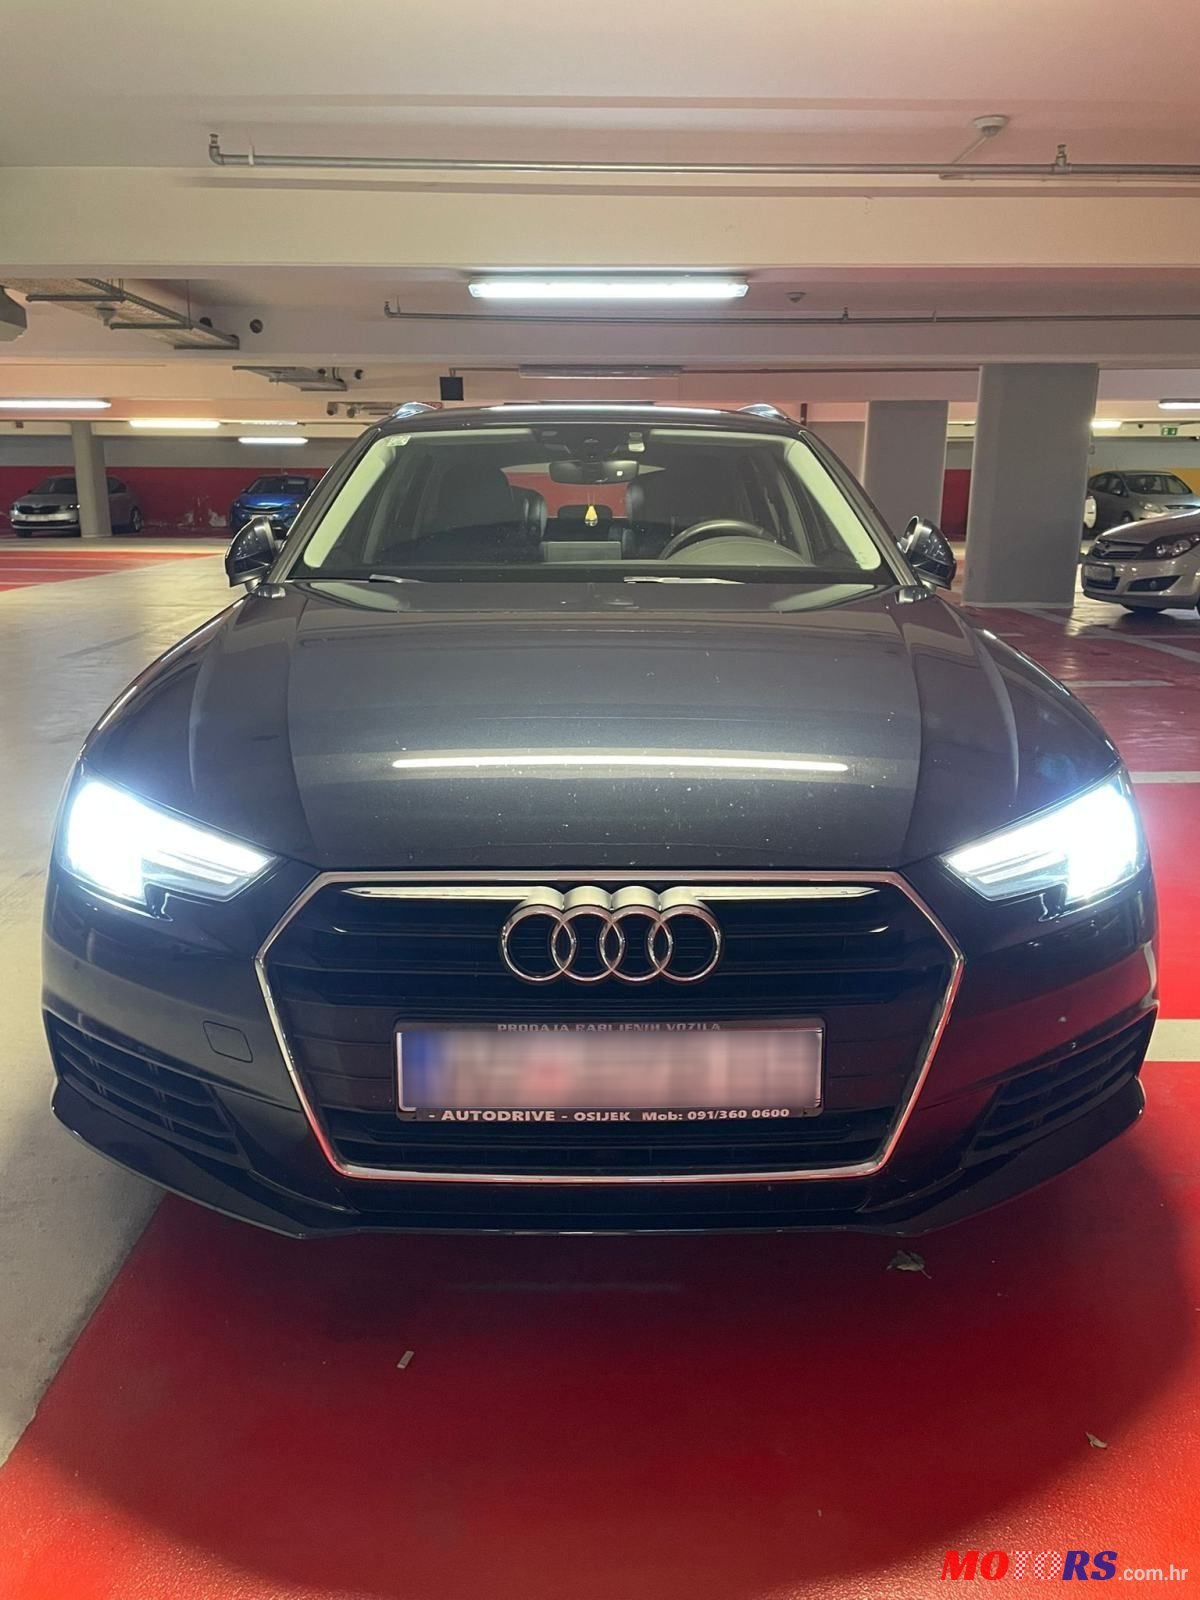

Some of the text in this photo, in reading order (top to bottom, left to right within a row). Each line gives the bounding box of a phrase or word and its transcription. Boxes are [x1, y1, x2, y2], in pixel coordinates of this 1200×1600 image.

[441, 1110, 556, 1121] AUTODRIVE
[573, 1111, 631, 1121] OSIJEK
[642, 1111, 683, 1121] Mob:
[687, 1109, 747, 1120] 091/360
[751, 1108, 790, 1118] 0600
